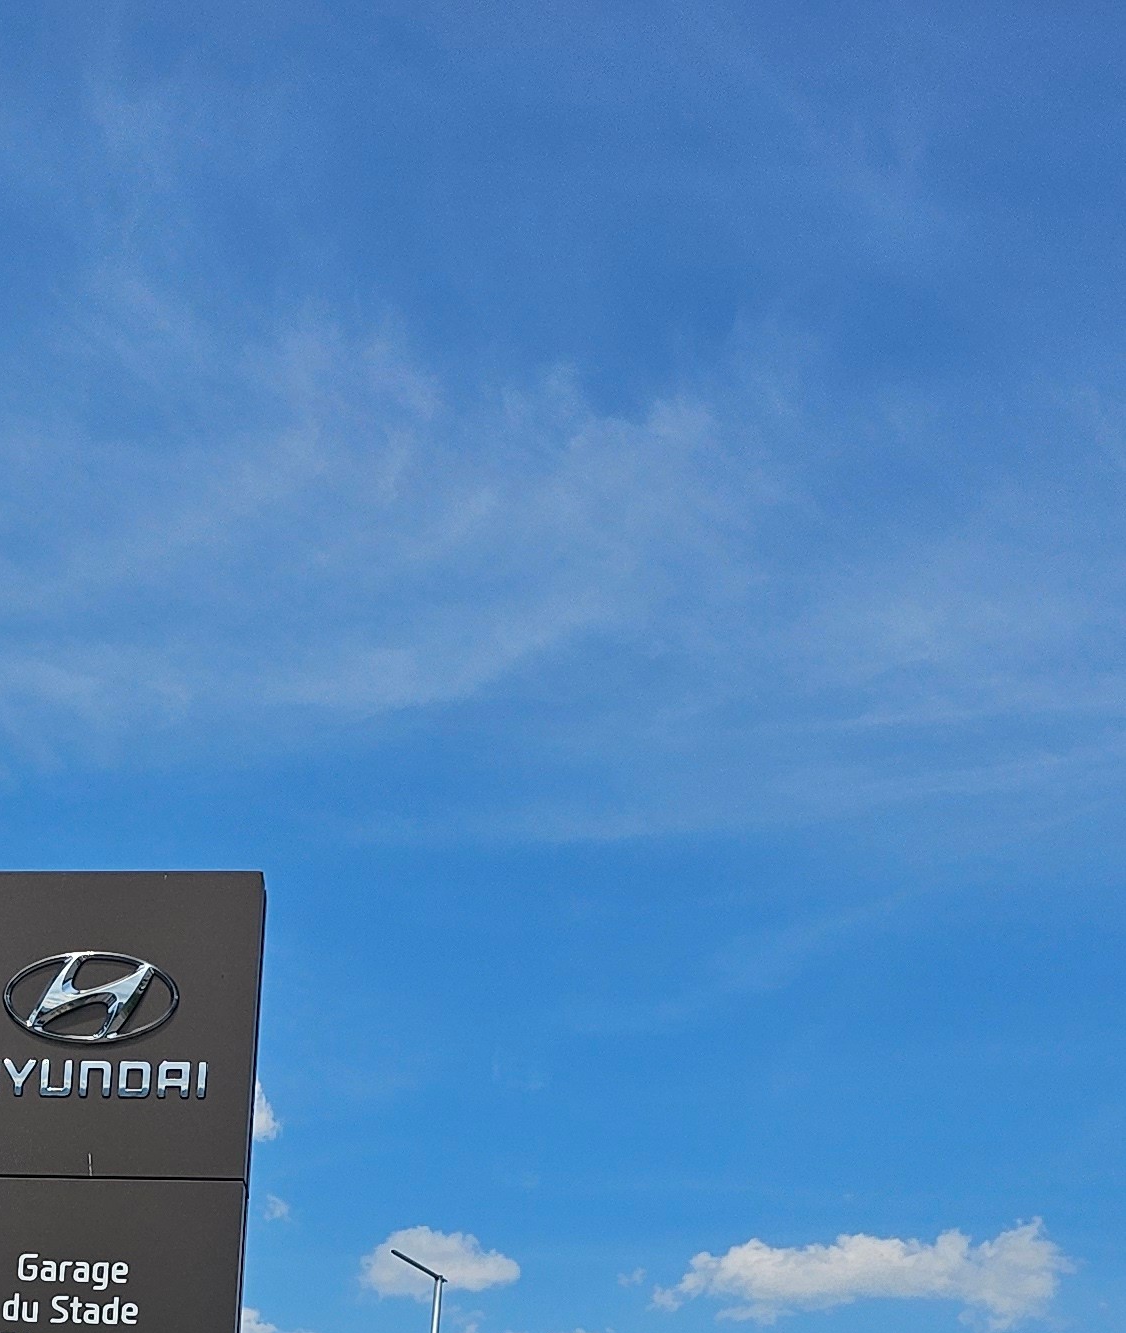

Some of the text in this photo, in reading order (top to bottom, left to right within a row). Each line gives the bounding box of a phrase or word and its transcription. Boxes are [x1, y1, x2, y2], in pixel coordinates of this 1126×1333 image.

[17, 1253, 129, 1290] Garage
[2, 1292, 139, 1325] du Stade
